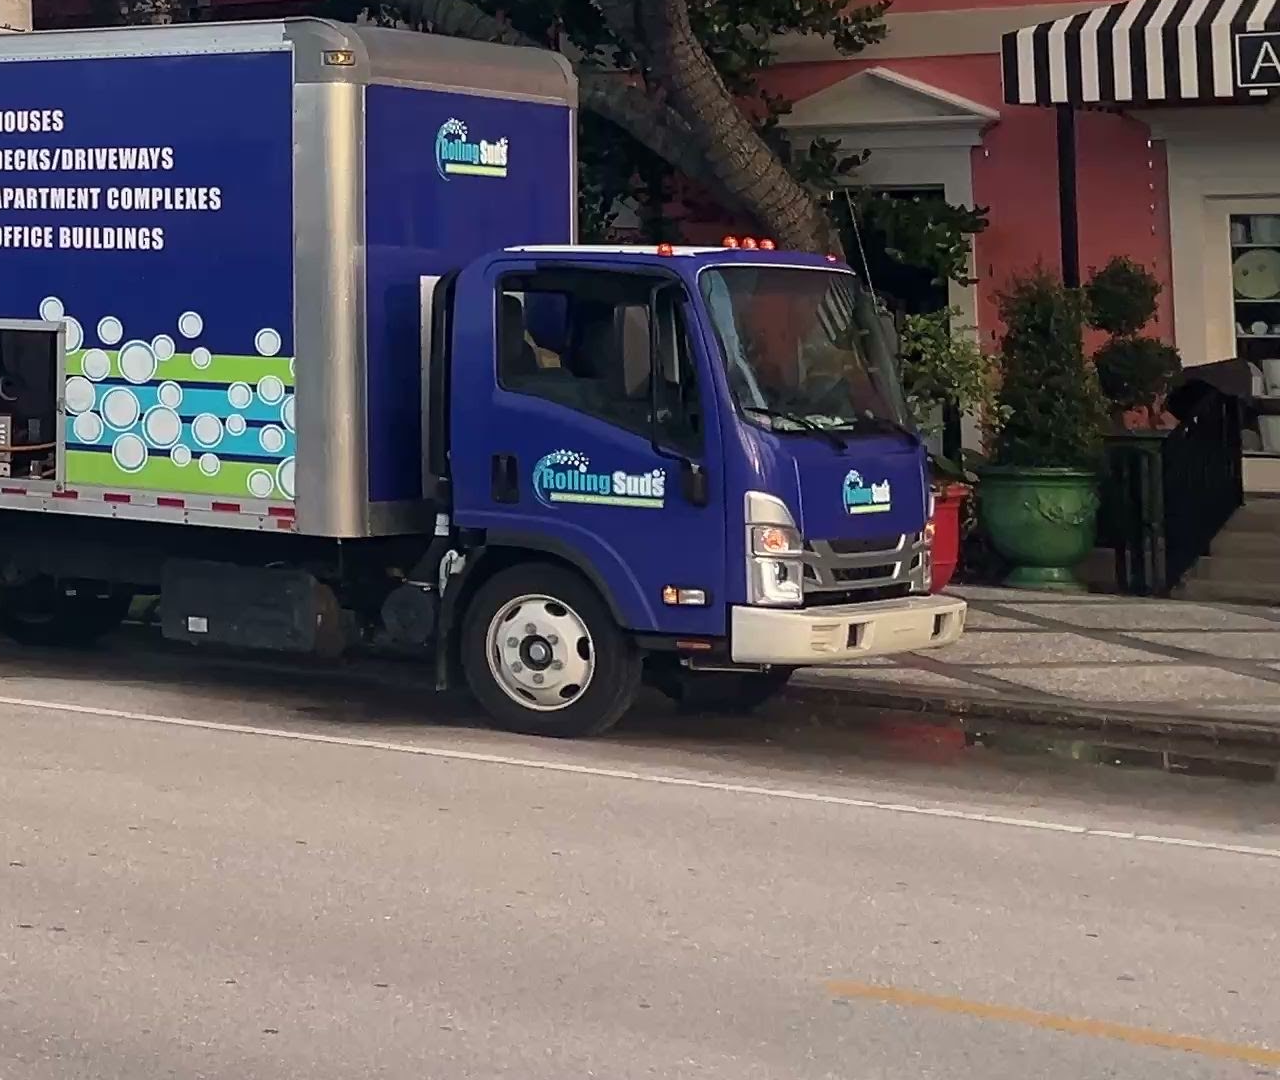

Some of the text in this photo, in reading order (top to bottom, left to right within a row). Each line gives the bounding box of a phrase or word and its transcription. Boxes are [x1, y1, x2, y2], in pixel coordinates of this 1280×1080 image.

[441, 138, 507, 166] Rolling Suds
[107, 187, 222, 210] COMPLEXES
[59, 226, 164, 250] BUILDINGS
[543, 468, 665, 497] Rolling Suds
